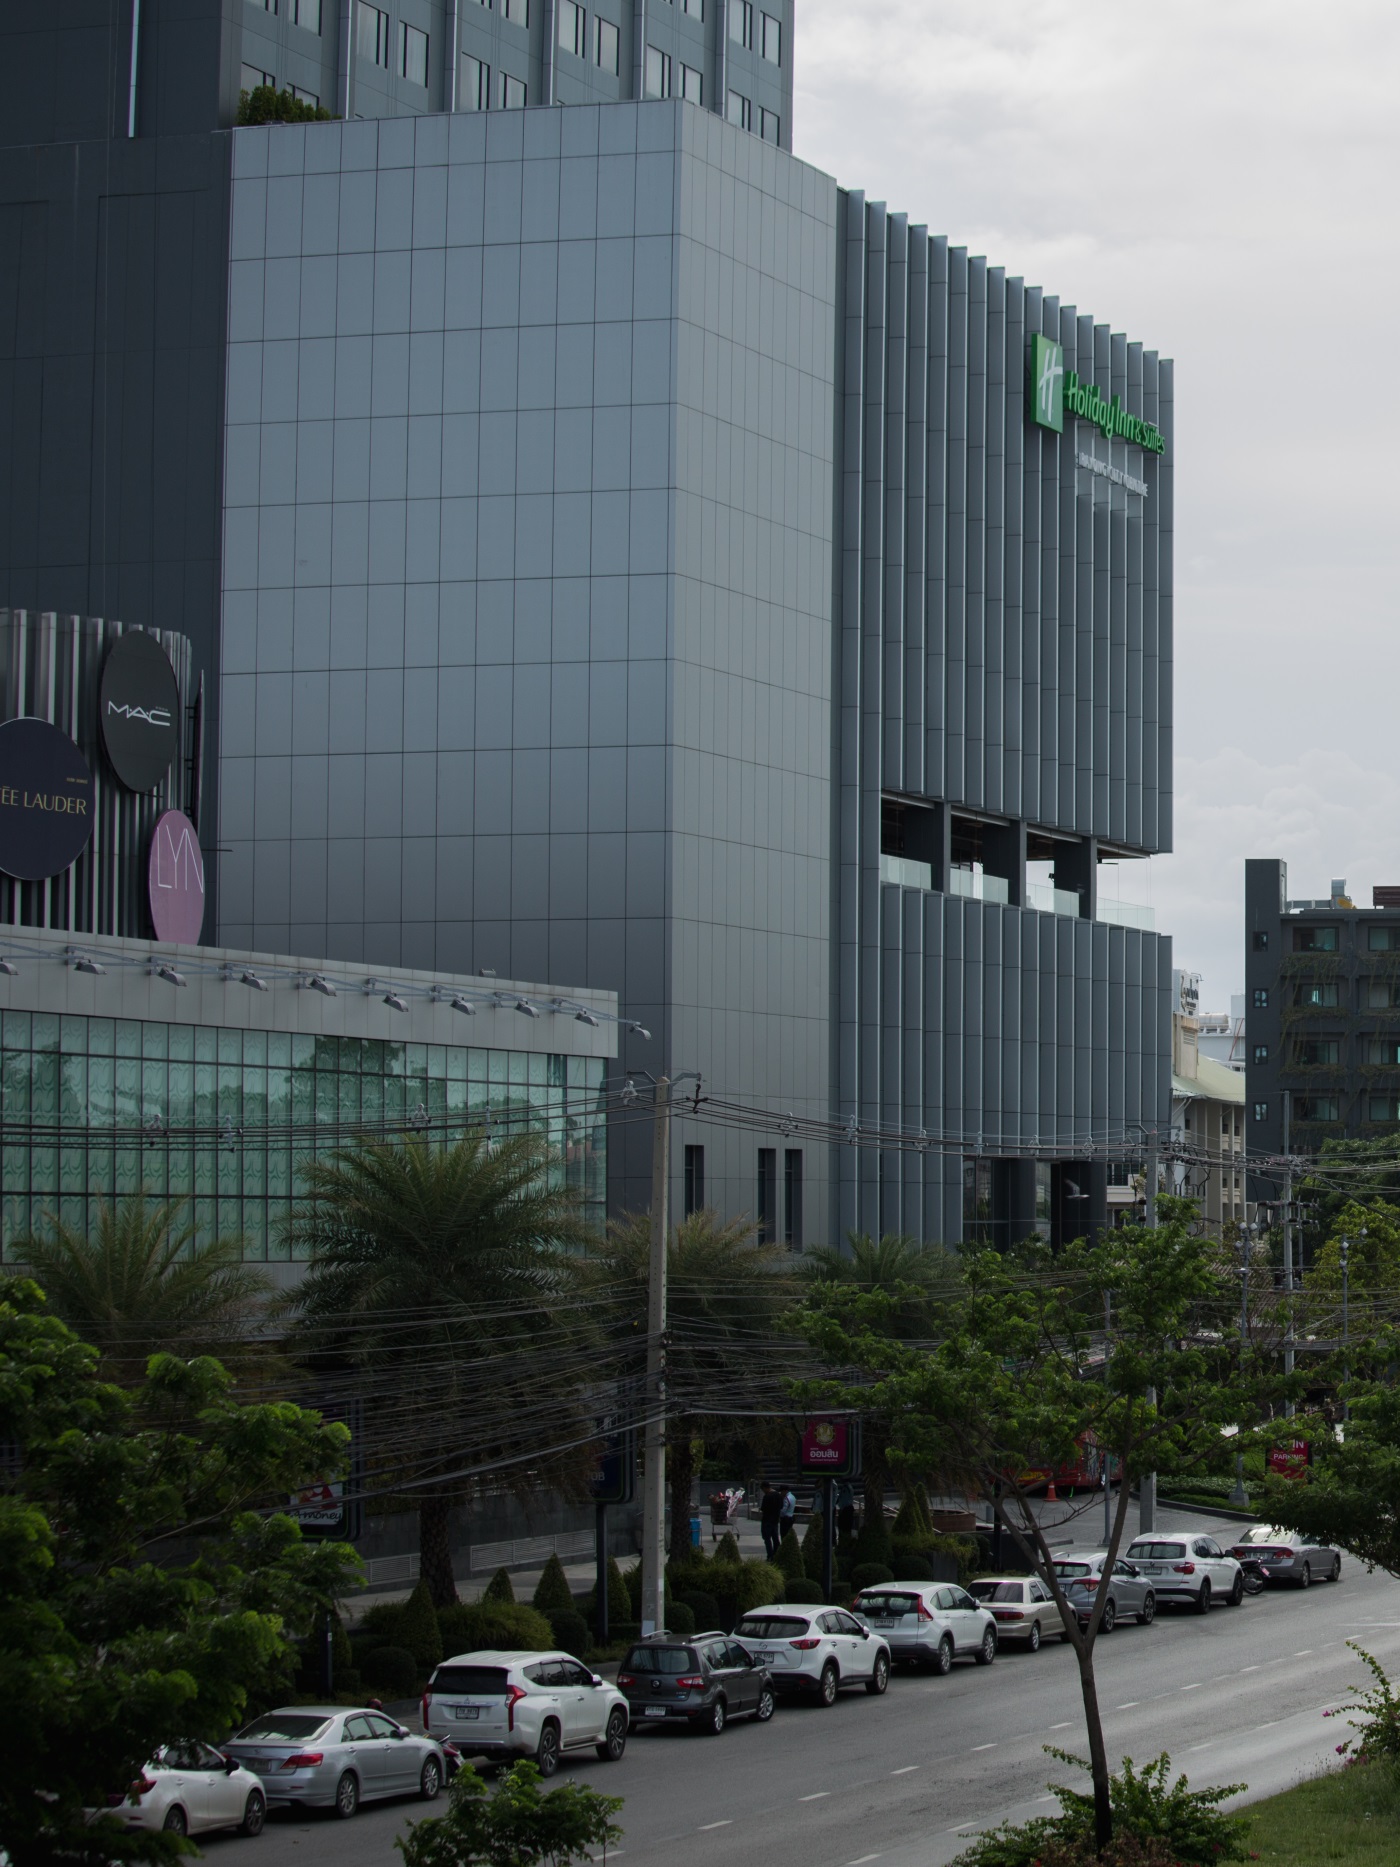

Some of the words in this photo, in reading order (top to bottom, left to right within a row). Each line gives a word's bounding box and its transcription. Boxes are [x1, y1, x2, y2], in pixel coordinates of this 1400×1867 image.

[1066, 371, 1115, 438] Holiday
[1115, 395, 1135, 441] Inn
[1135, 419, 1143, 443] &
[1143, 421, 1166, 455] Suites
[24, 791, 87, 816] LAUDER
[156, 823, 204, 894] LYN
[809, 1448, 839, 1458] ออมสิน
